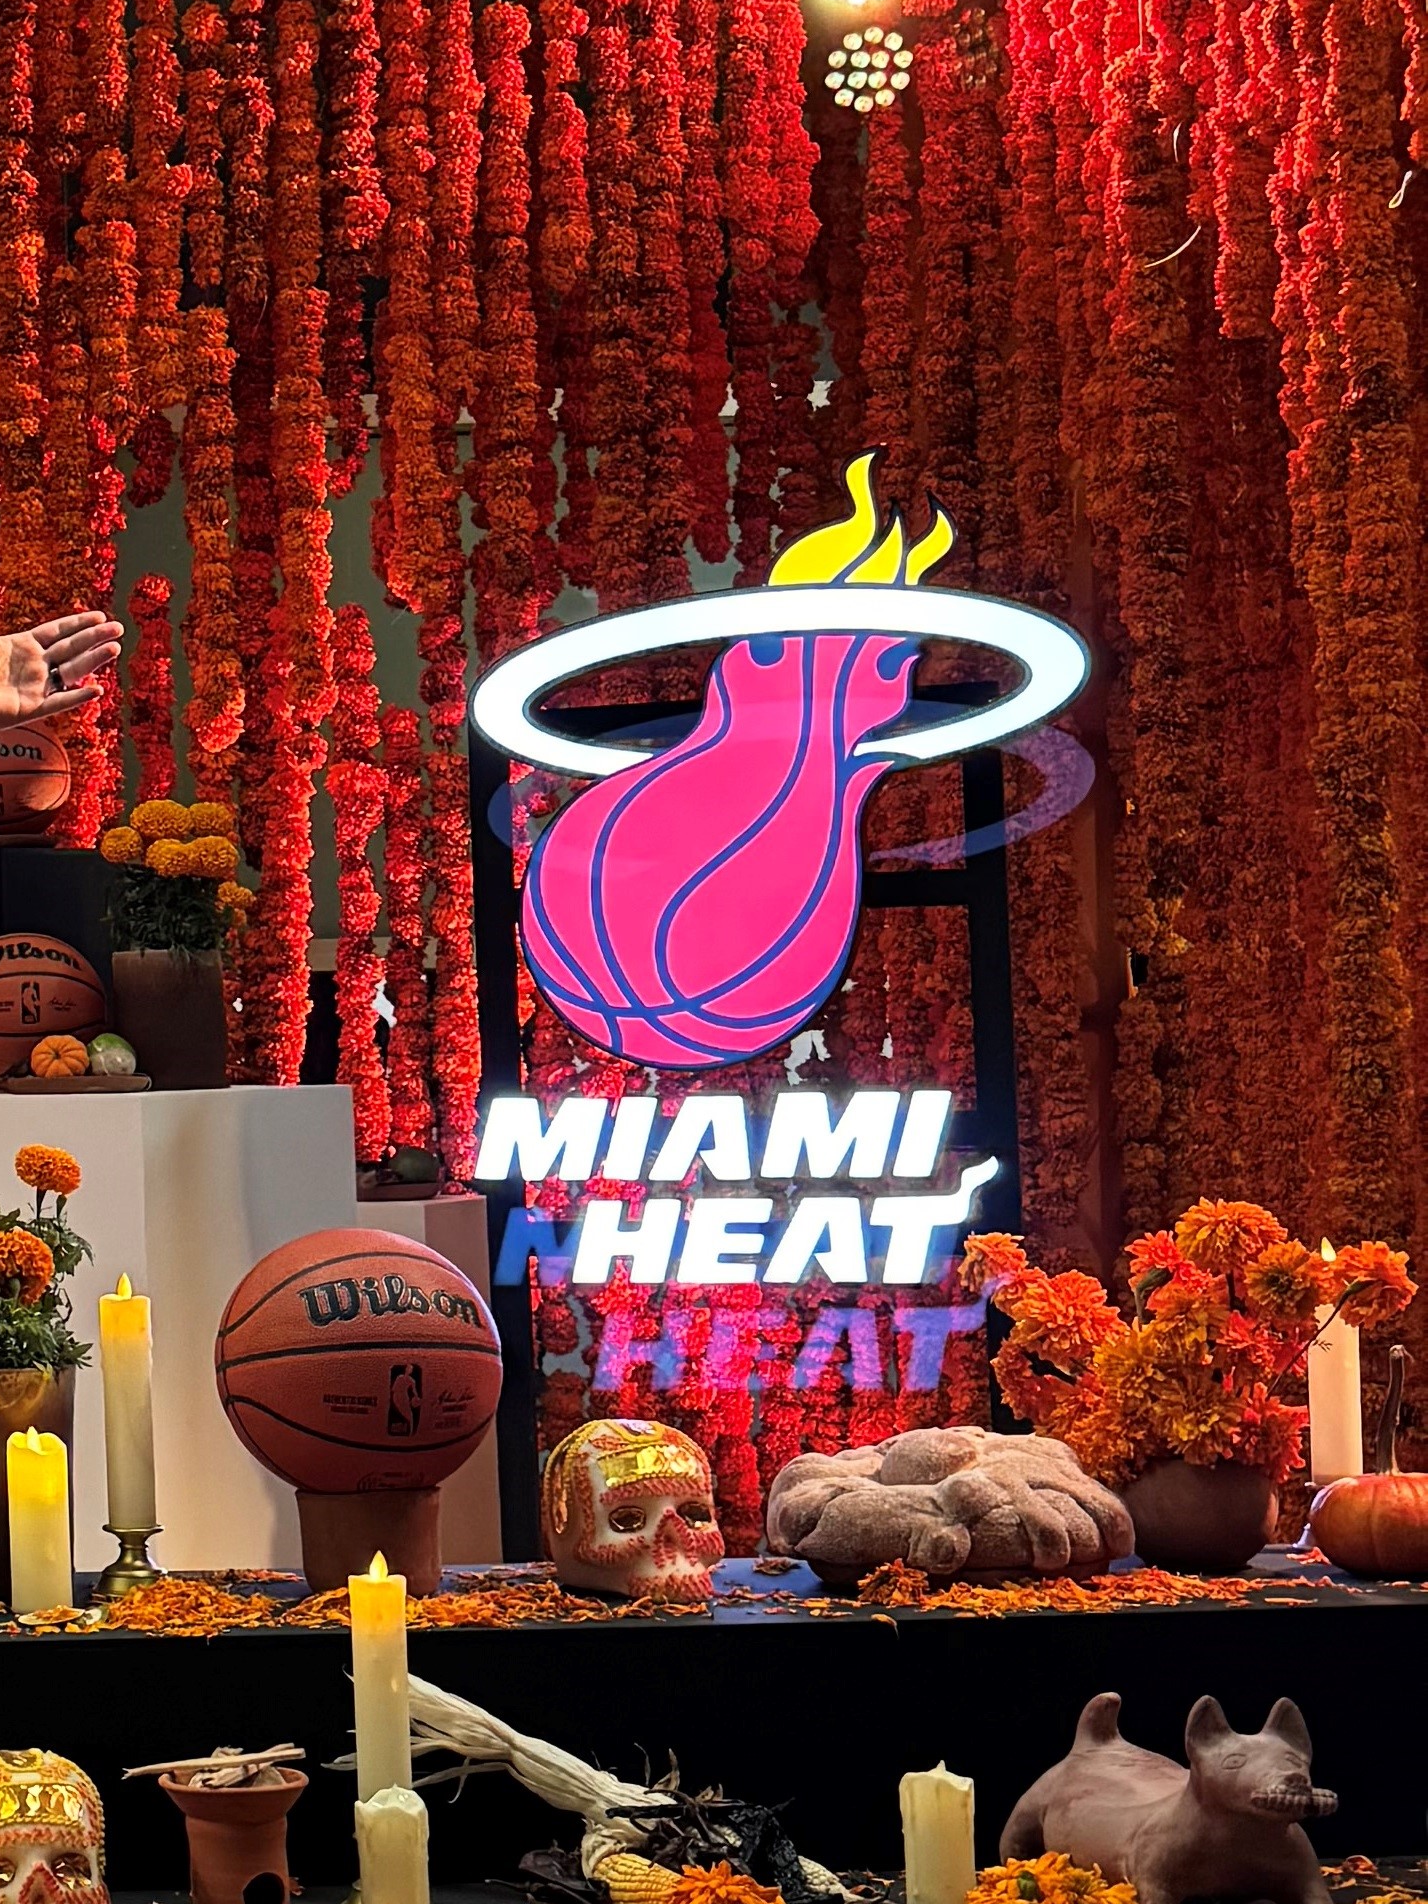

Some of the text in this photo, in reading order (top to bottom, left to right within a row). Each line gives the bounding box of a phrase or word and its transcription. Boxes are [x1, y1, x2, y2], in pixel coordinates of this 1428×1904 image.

[473, 1089, 953, 1183] MIAMI
[572, 1154, 1000, 1285] HEAT
[298, 1271, 486, 1330] Wilson
